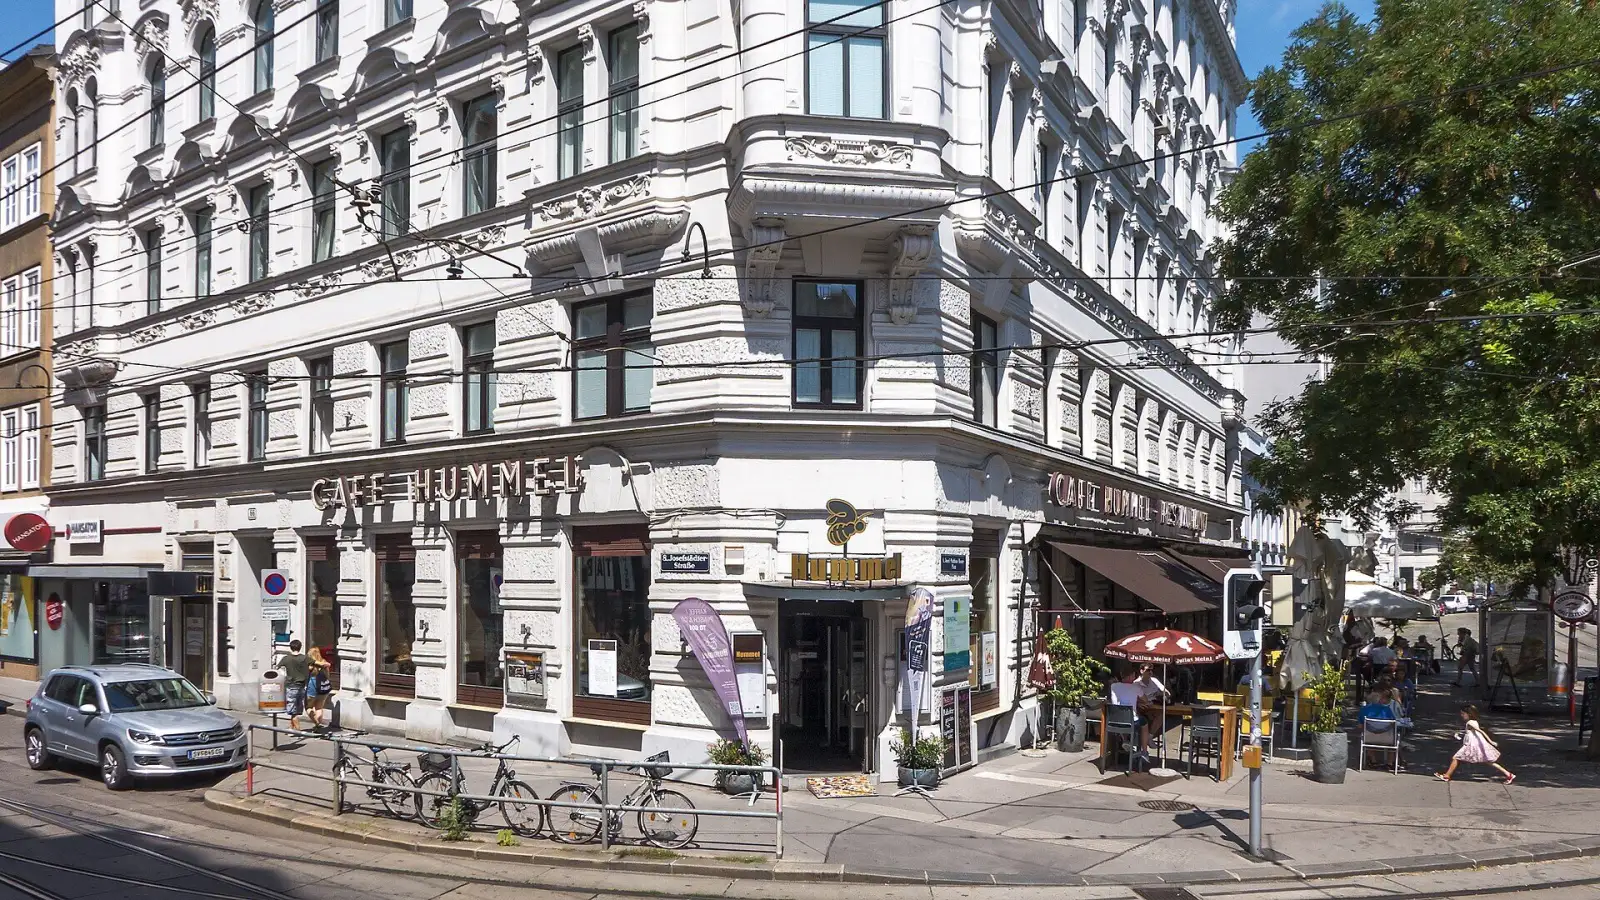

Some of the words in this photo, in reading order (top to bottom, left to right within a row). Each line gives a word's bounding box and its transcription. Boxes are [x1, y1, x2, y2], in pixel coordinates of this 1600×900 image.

[311, 472, 386, 511] CAFE
[413, 455, 580, 503] HUMMEL
[12, 522, 47, 543] HANSATON
[71, 521, 98, 534] HANSATON
[791, 552, 902, 581] Hummel
